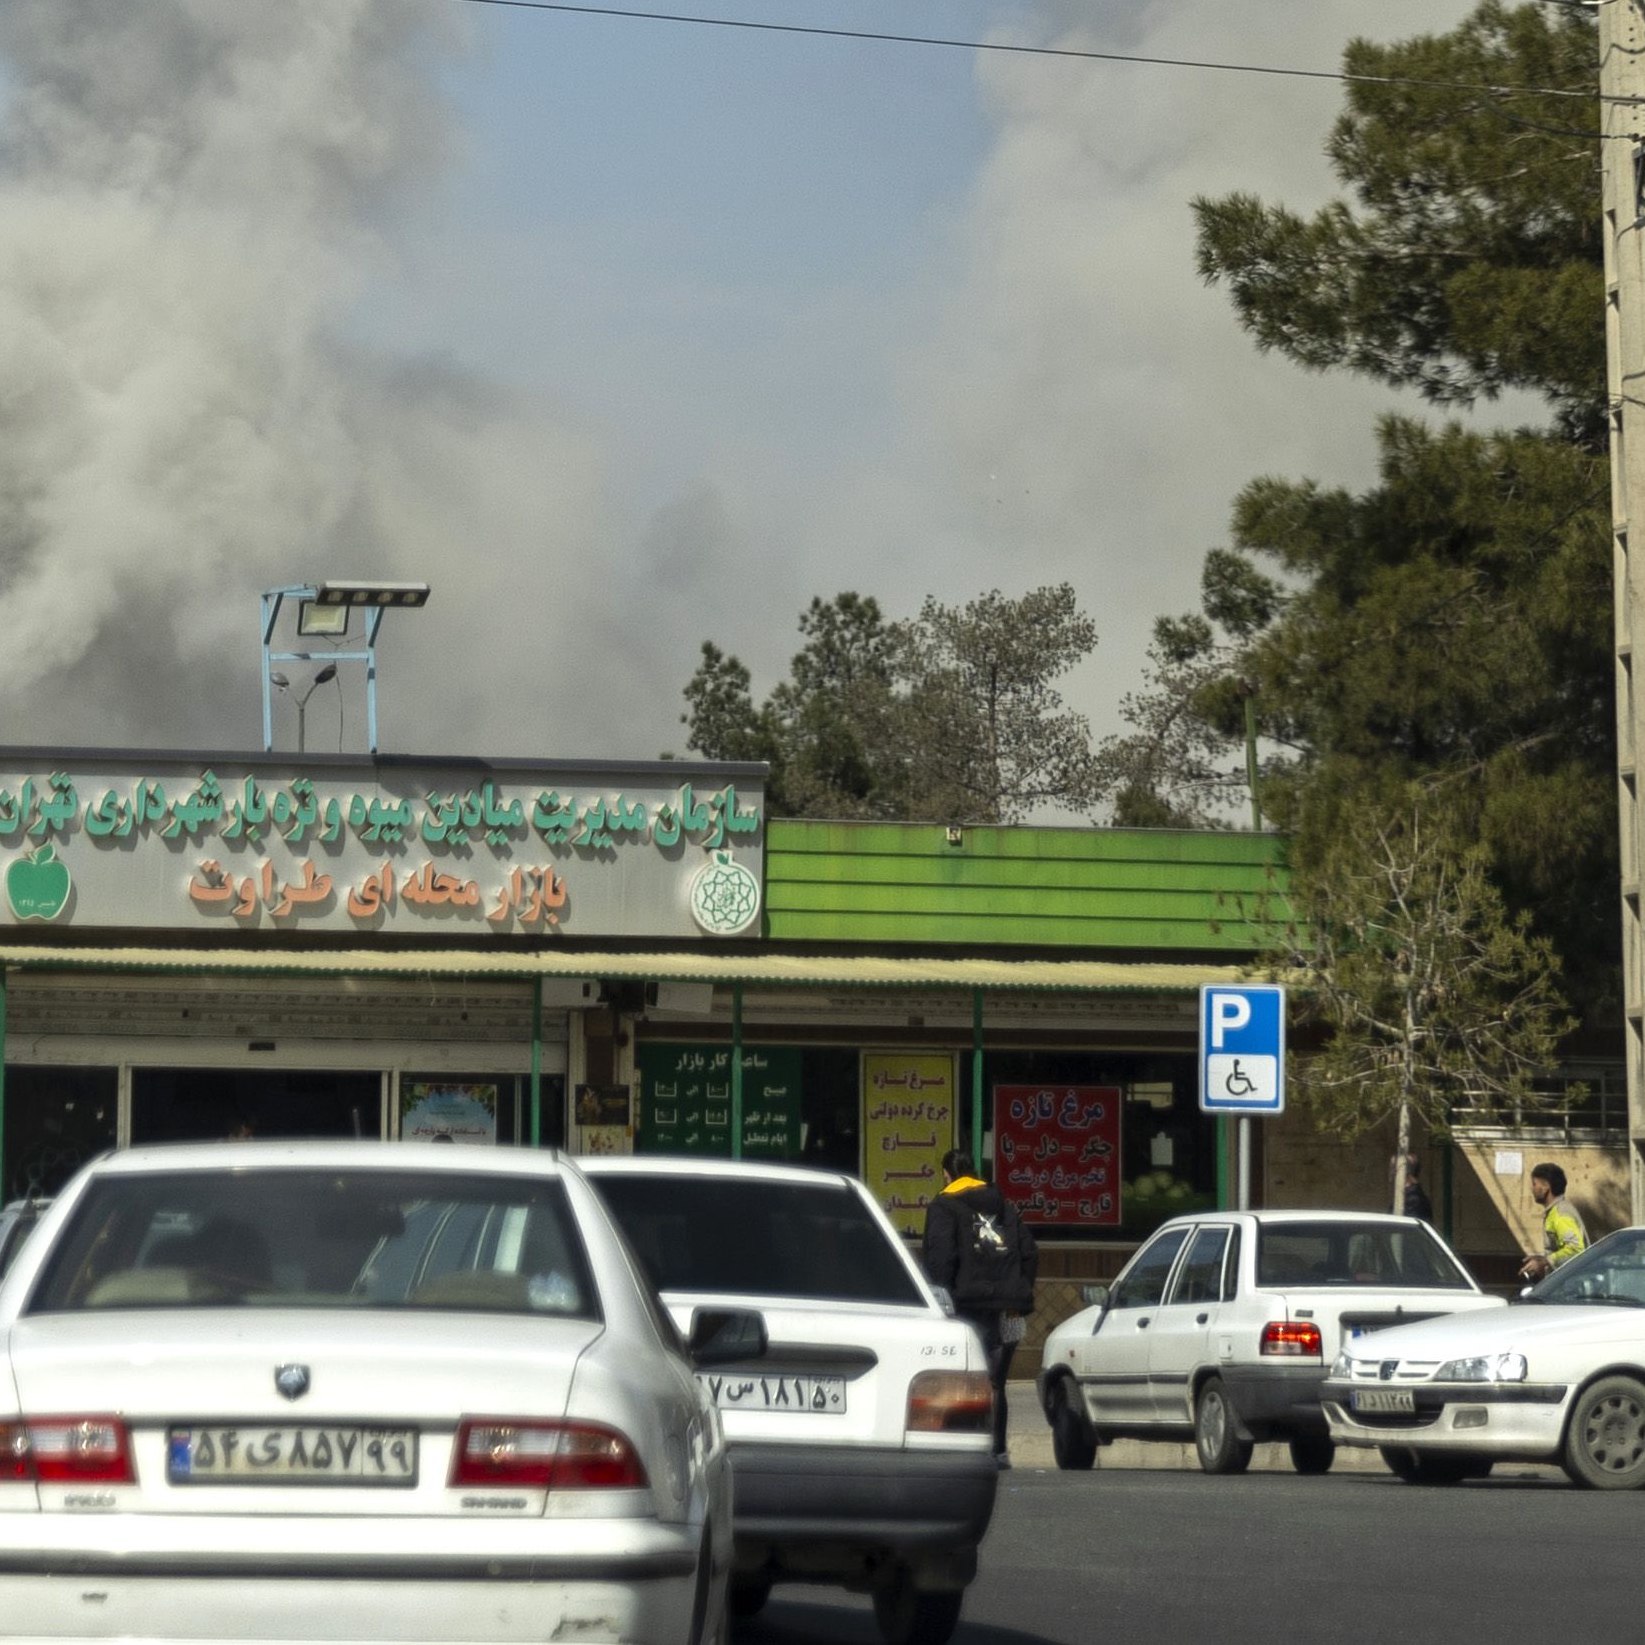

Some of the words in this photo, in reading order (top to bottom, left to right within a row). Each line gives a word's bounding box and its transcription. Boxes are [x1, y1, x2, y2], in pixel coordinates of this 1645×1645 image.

[85, 768, 224, 838] شهرداری
[220, 774, 266, 842] بار
[273, 777, 318, 842] تره
[421, 778, 524, 845] میادین
[656, 782, 758, 849] سازمان
[319, 797, 340, 841] و
[349, 793, 413, 842] میوه
[533, 790, 648, 848] مدیریت
[189, 858, 333, 917] طراوت
[347, 860, 393, 918] ای
[402, 860, 481, 906] محله
[486, 865, 568, 924] بازار
[1212, 994, 1251, 1048] P
[675, 1053, 704, 1070] بازار
[708, 1053, 728, 1070] کار
[740, 1054, 768, 1067] ساع
[763, 1085, 787, 1098] صبح
[873, 1070, 907, 1089] تازه
[909, 1070, 945, 1089] مرغ
[772, 1111, 787, 1123] بعد
[870, 1101, 898, 1120] دولتی
[901, 1102, 925, 1121] کرده
[927, 1104, 948, 1121] چرخ
[1010, 1090, 1054, 1128] تازه
[1058, 1089, 1104, 1129] مرغ
[882, 1131, 936, 1151] قارچ
[1001, 1133, 1015, 1162] پا
[1034, 1134, 1058, 1161] دل
[1079, 1135, 1113, 1162] جگر
[883, 1164, 934, 1182] جگر
[1009, 1166, 1049, 1188] درشت
[1051, 1165, 1077, 1189] مرغ
[1079, 1167, 1106, 1188] تخم
[1007, 1191, 1058, 1218] بوقلمو
[1078, 1193, 1112, 1217] قارچ
[760, 1376, 804, 1405] ۱۸۱
[812, 1387, 839, 1409] ۵۰
[194, 1430, 239, 1468] ۵۴
[246, 1432, 281, 1467] ی
[288, 1431, 357, 1470] ۸۵۷
[367, 1440, 410, 1473] ۹۹
